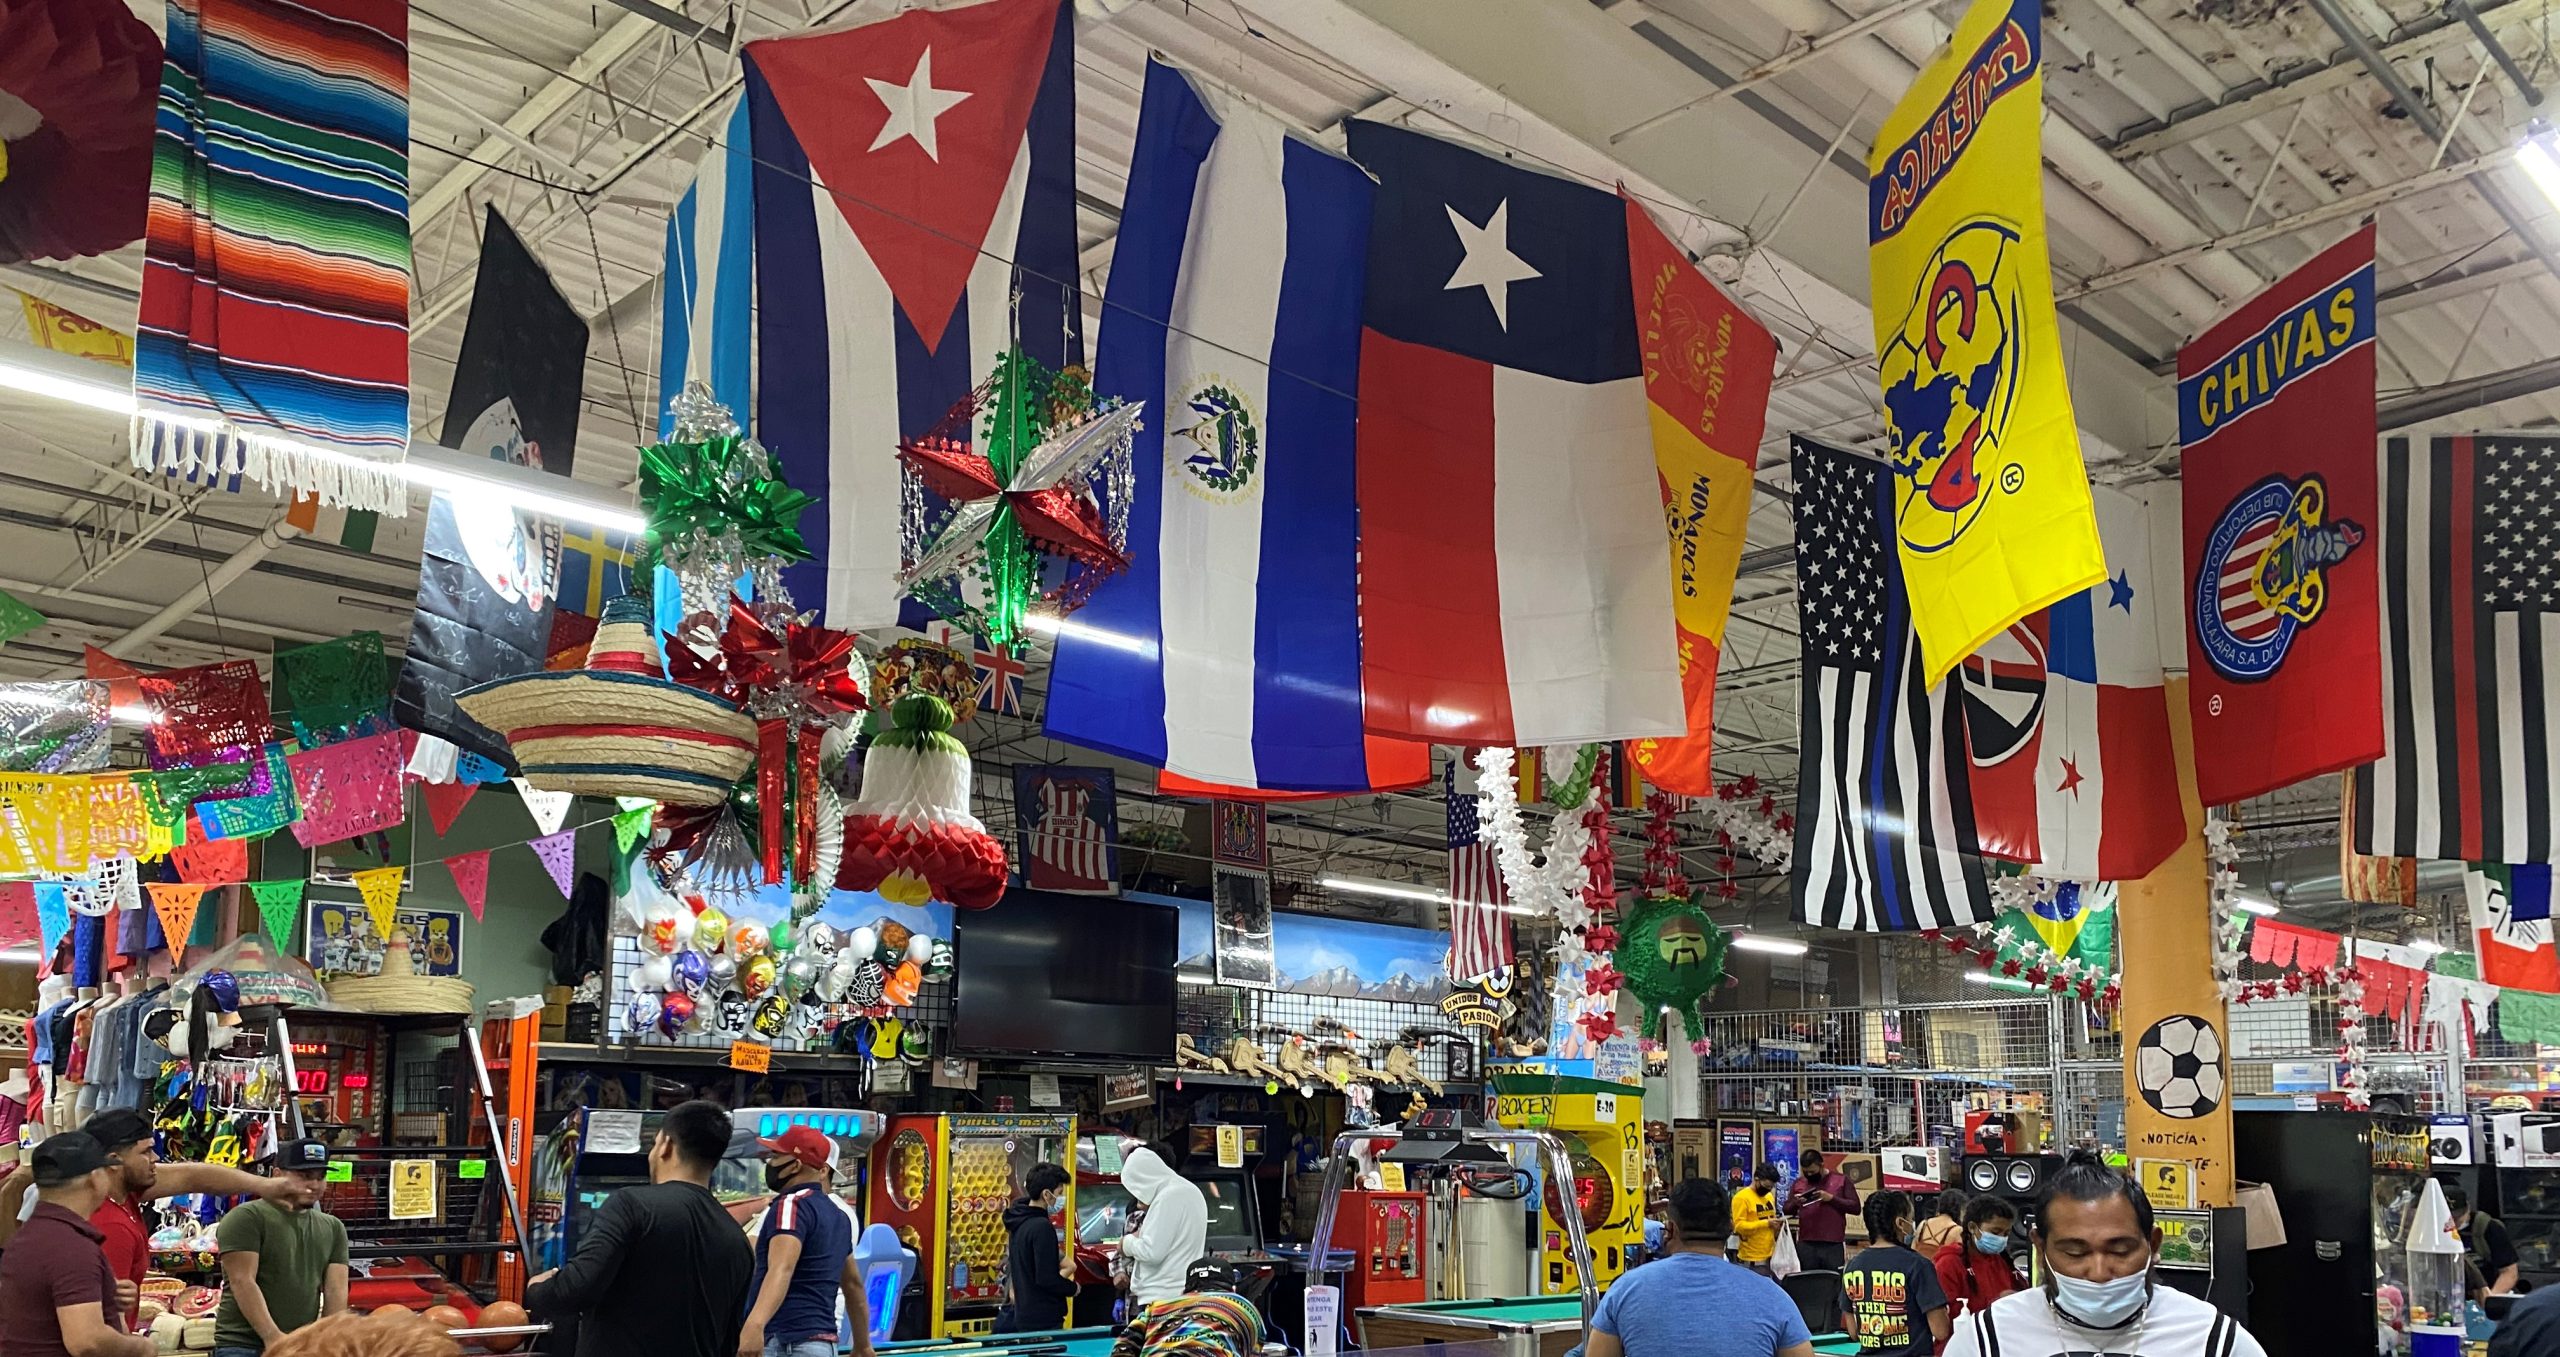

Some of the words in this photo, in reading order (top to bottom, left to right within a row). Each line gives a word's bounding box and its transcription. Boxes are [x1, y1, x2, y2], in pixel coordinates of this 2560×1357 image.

[2199, 287, 2356, 428] CHIVAS
[1701, 312, 1735, 436] MONARCAS
[1681, 471, 1712, 598] MONARCAS
[2201, 571, 2236, 661] GUADALAJARA
[1446, 994, 1478, 1009] UNIDOS
[1483, 997, 1498, 1008] CON
[1462, 1010, 1500, 1027] PASION
[1501, 1096, 1553, 1117] BOXER
[1871, 1270, 1906, 1303] BIG
[1857, 1301, 1886, 1315] THEN
[1883, 1333, 1910, 1346] 2018
